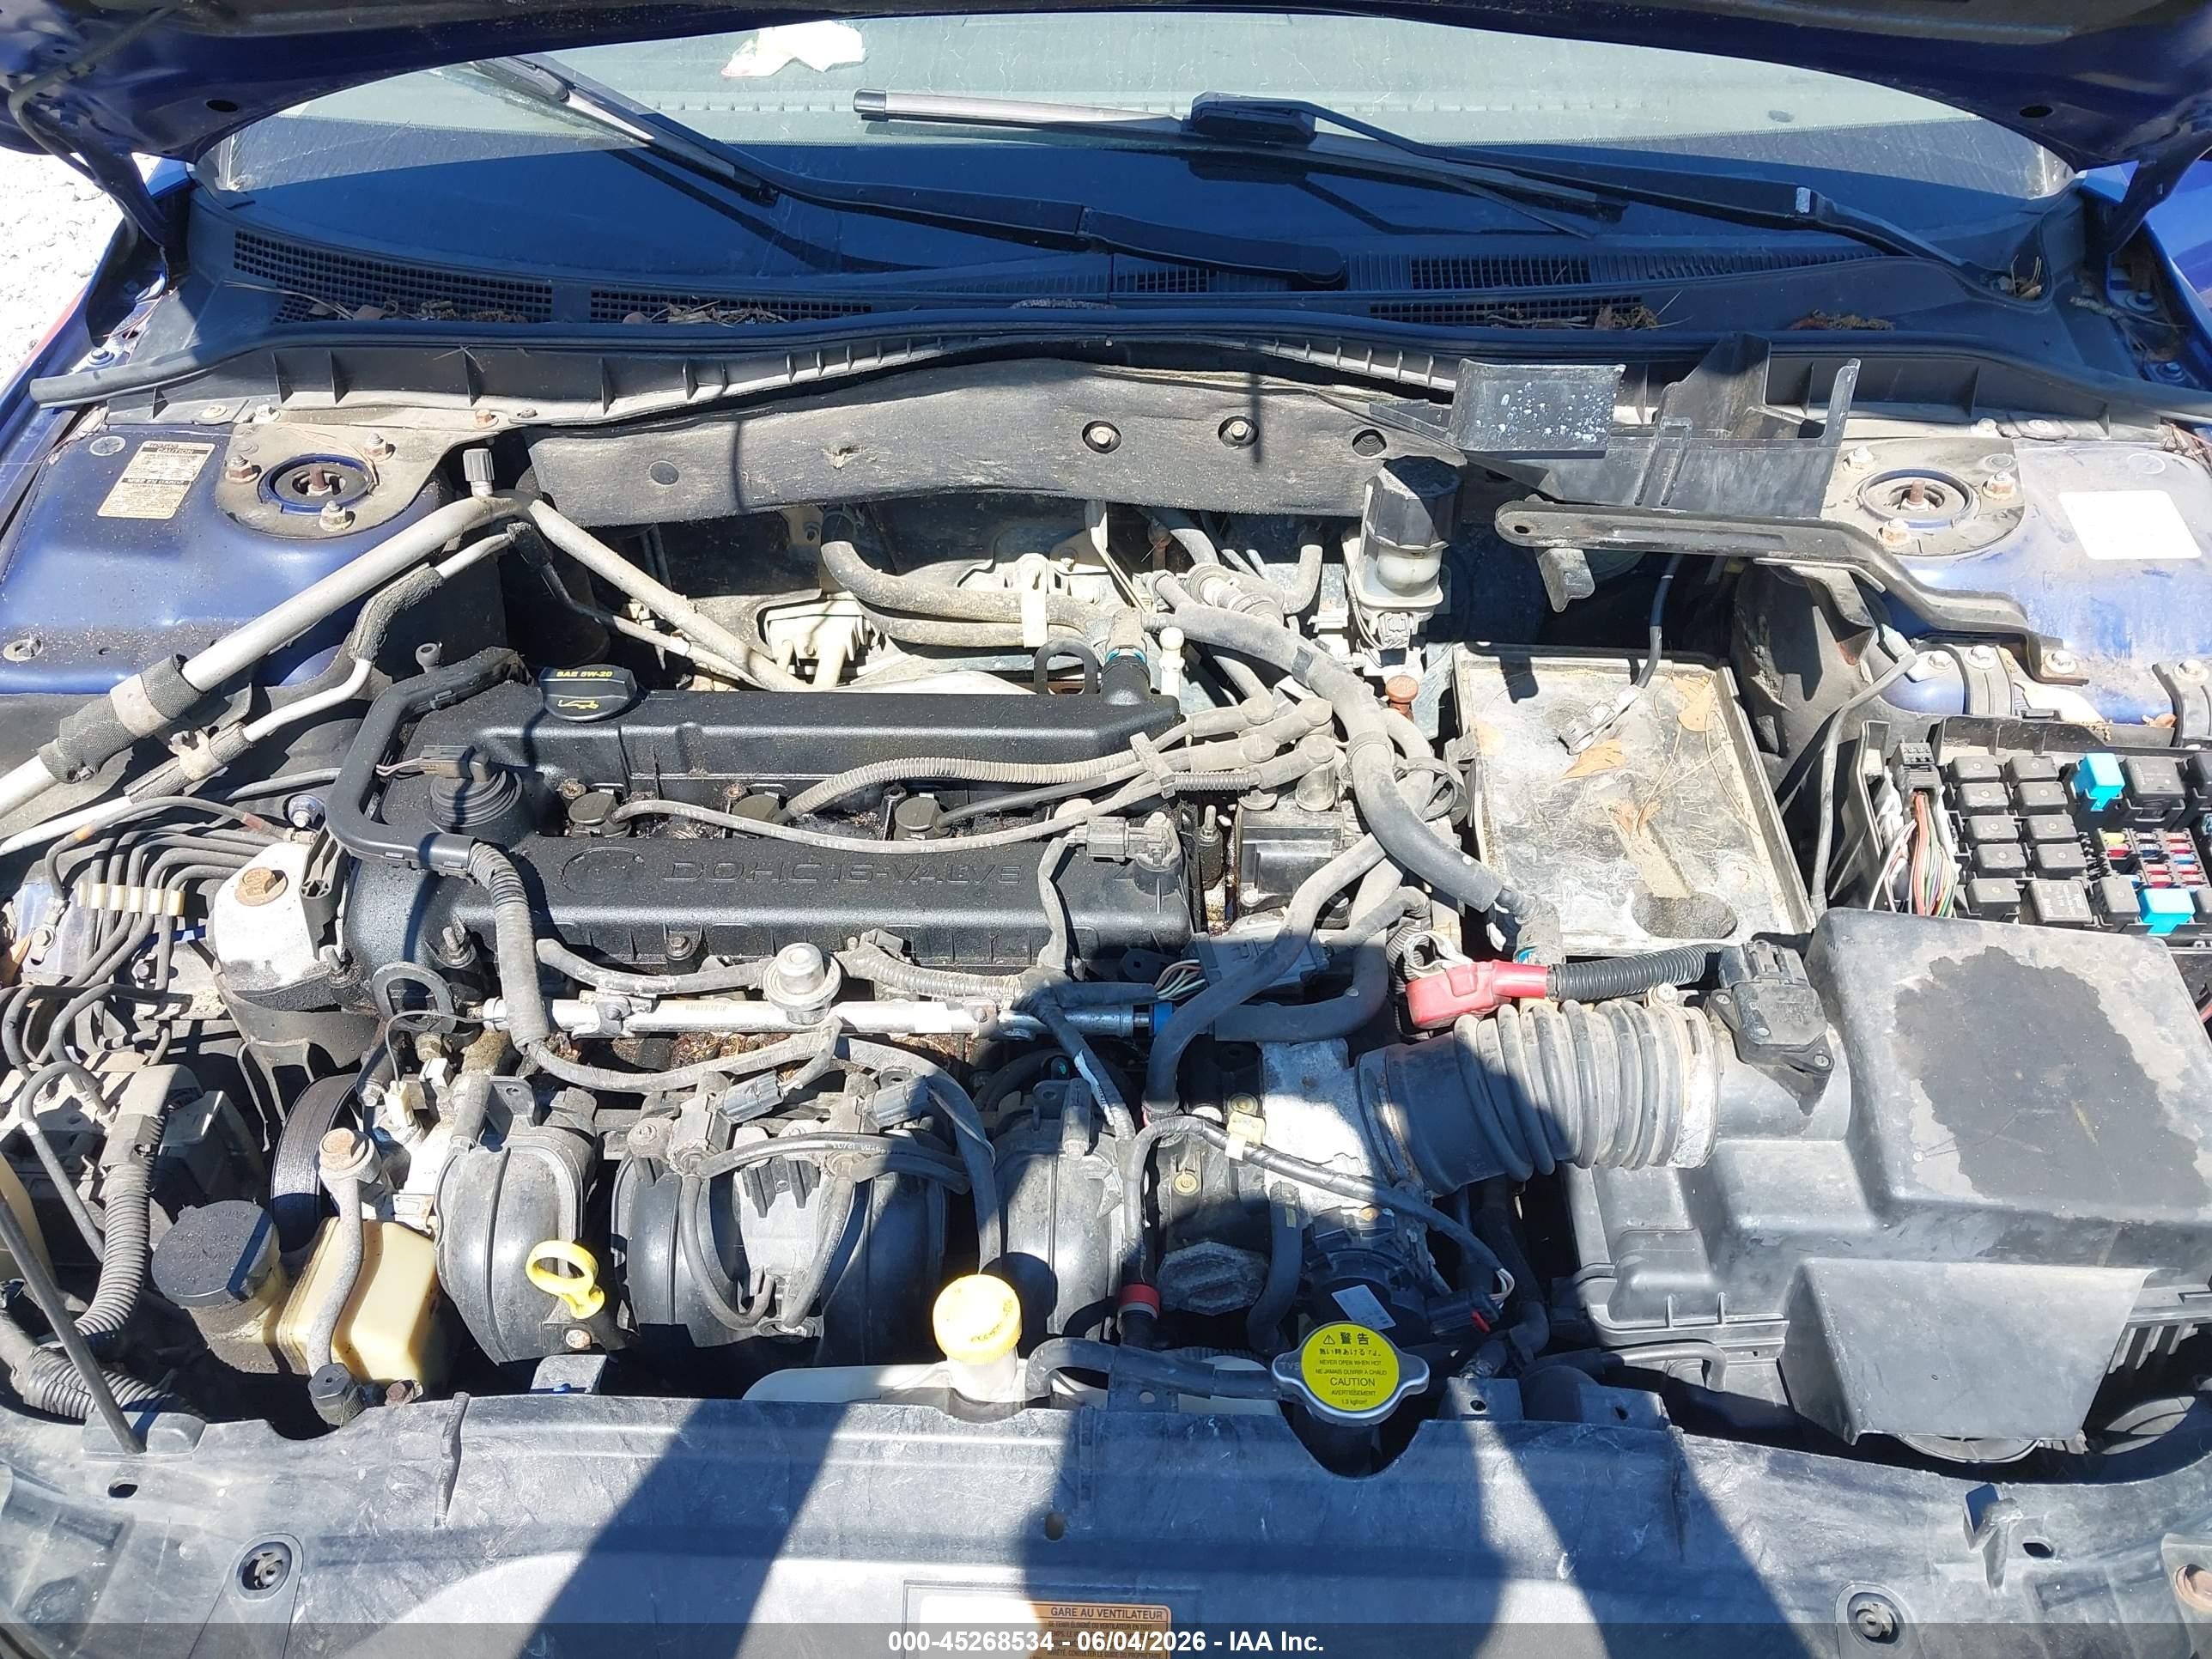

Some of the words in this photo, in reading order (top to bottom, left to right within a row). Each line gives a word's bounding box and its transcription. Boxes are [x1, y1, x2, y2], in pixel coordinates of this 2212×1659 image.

[662, 861, 822, 883] DOHC
[829, 863, 1023, 885] 16-VALVE
[1330, 1377, 1376, 1387] CAUTION
[1051, 1607, 1078, 1616] GARE
[1080, 1607, 1094, 1617] AU
[1097, 1608, 1164, 1620] VENTILATEUR
